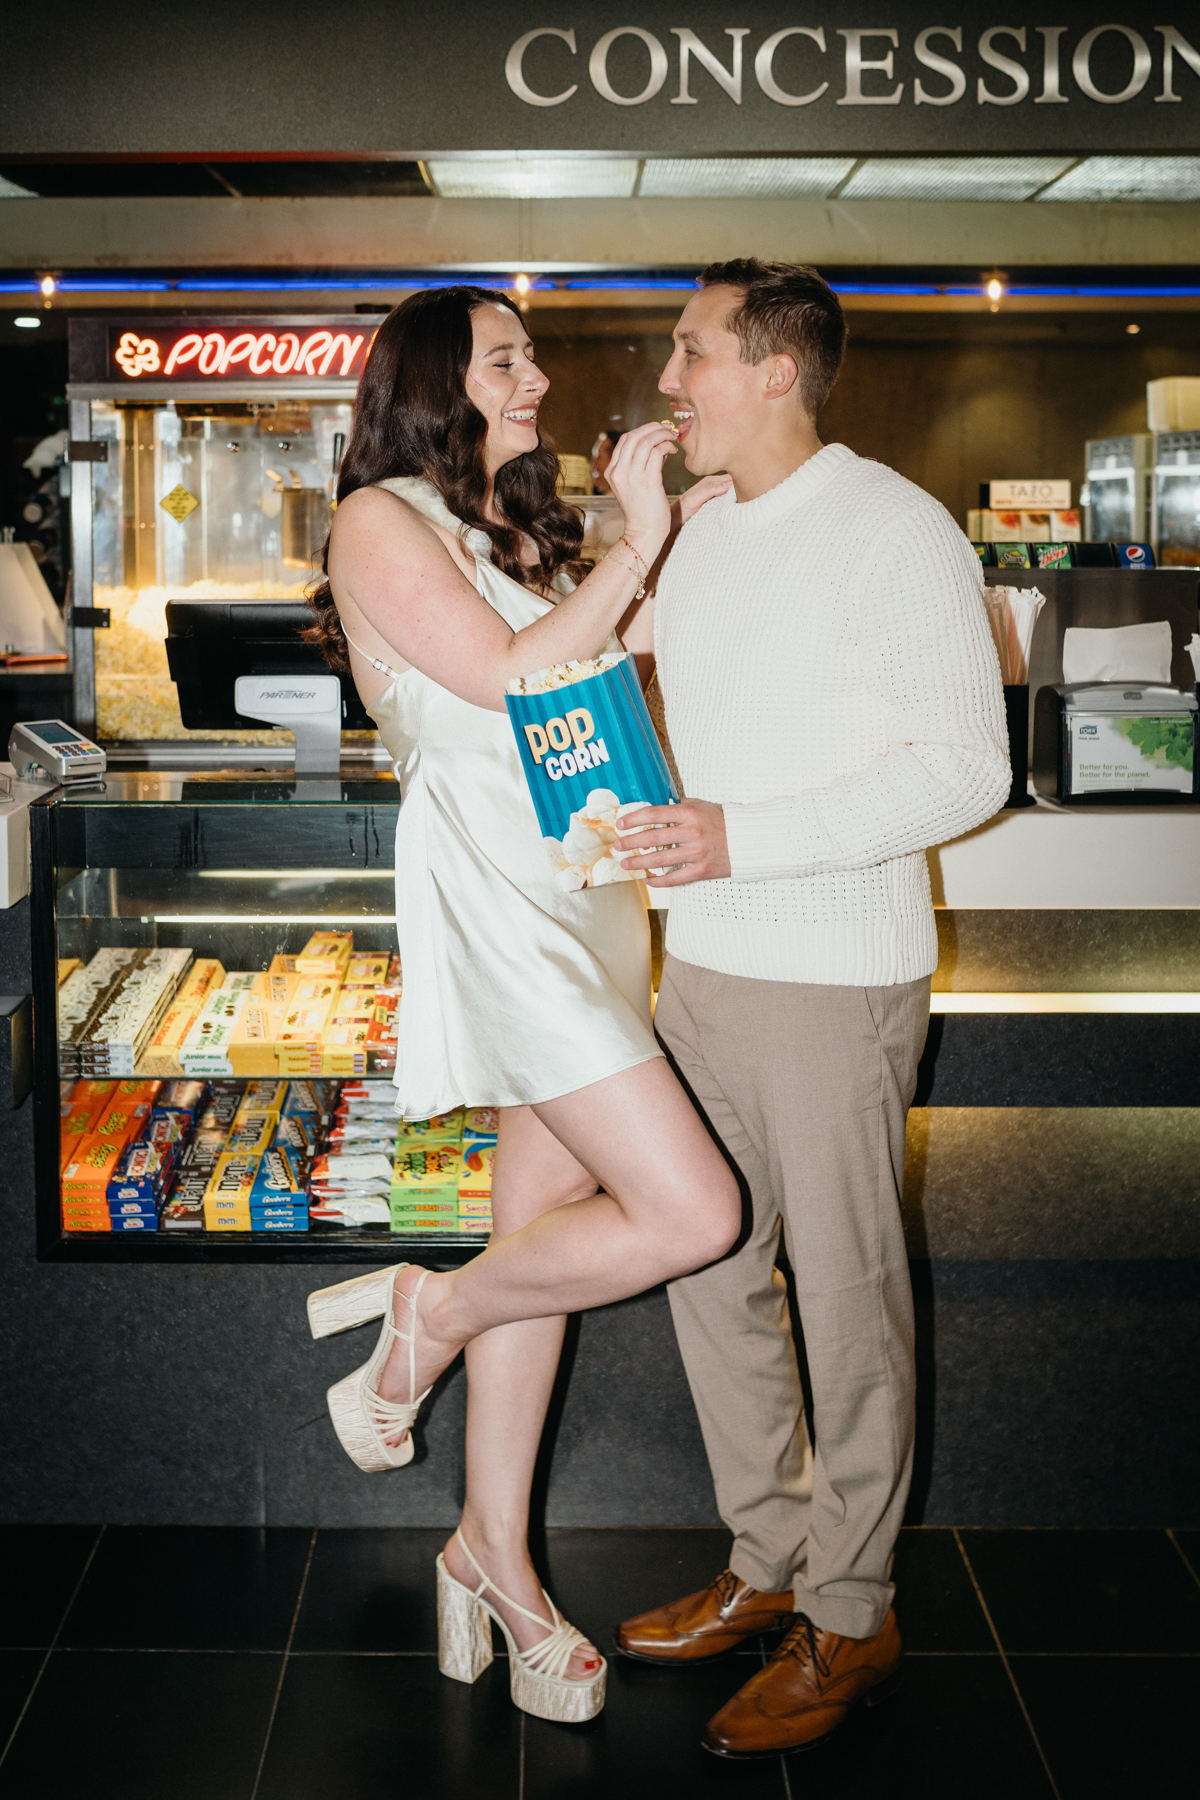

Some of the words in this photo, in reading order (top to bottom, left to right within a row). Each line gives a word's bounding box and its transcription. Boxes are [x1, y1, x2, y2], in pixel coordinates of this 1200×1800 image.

[163, 331, 365, 376] POPCORN
[260, 690, 316, 699] PARTNER
[523, 707, 596, 765] POP
[1080, 727, 1097, 735] TORK
[545, 738, 610, 781] CORN
[265, 1151, 292, 1189] Goobers
